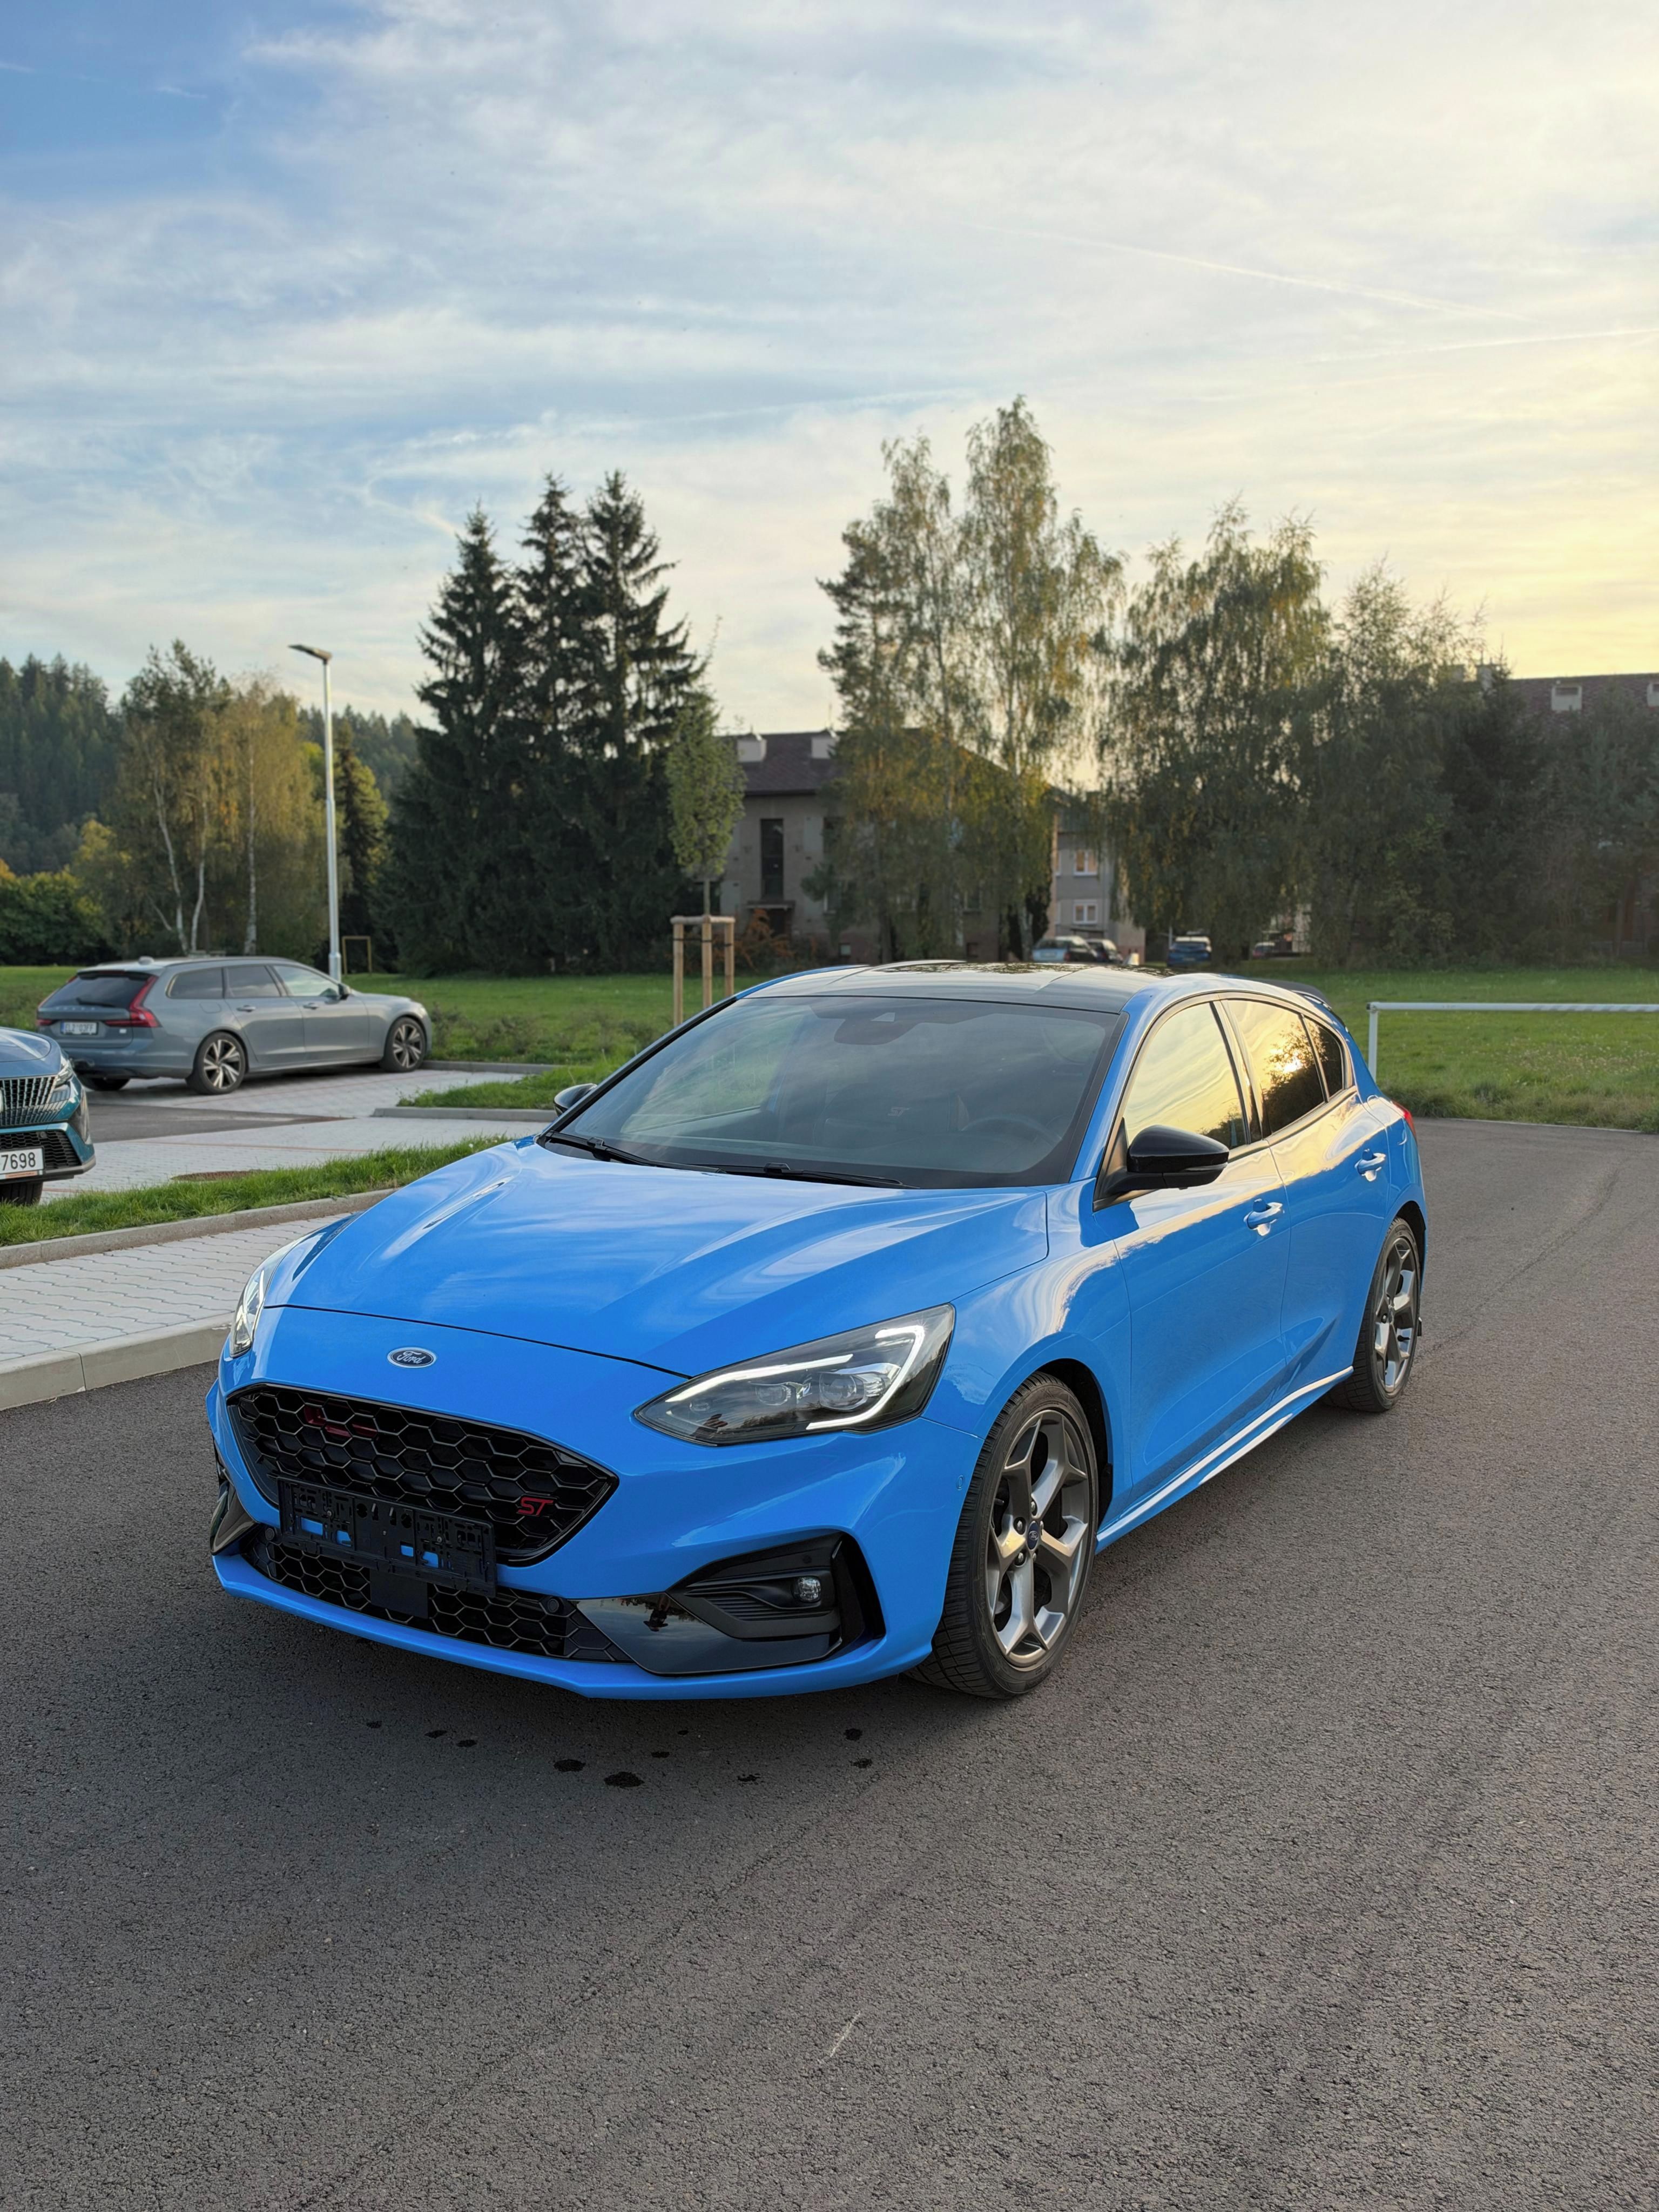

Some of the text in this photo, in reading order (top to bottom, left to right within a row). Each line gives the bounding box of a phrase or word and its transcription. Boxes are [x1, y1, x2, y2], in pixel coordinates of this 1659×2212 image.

[888, 1106, 910, 1117] ST
[1, 1152, 36, 1171] 7698
[397, 1351, 426, 1364] Ford
[518, 1496, 554, 1516] ST
